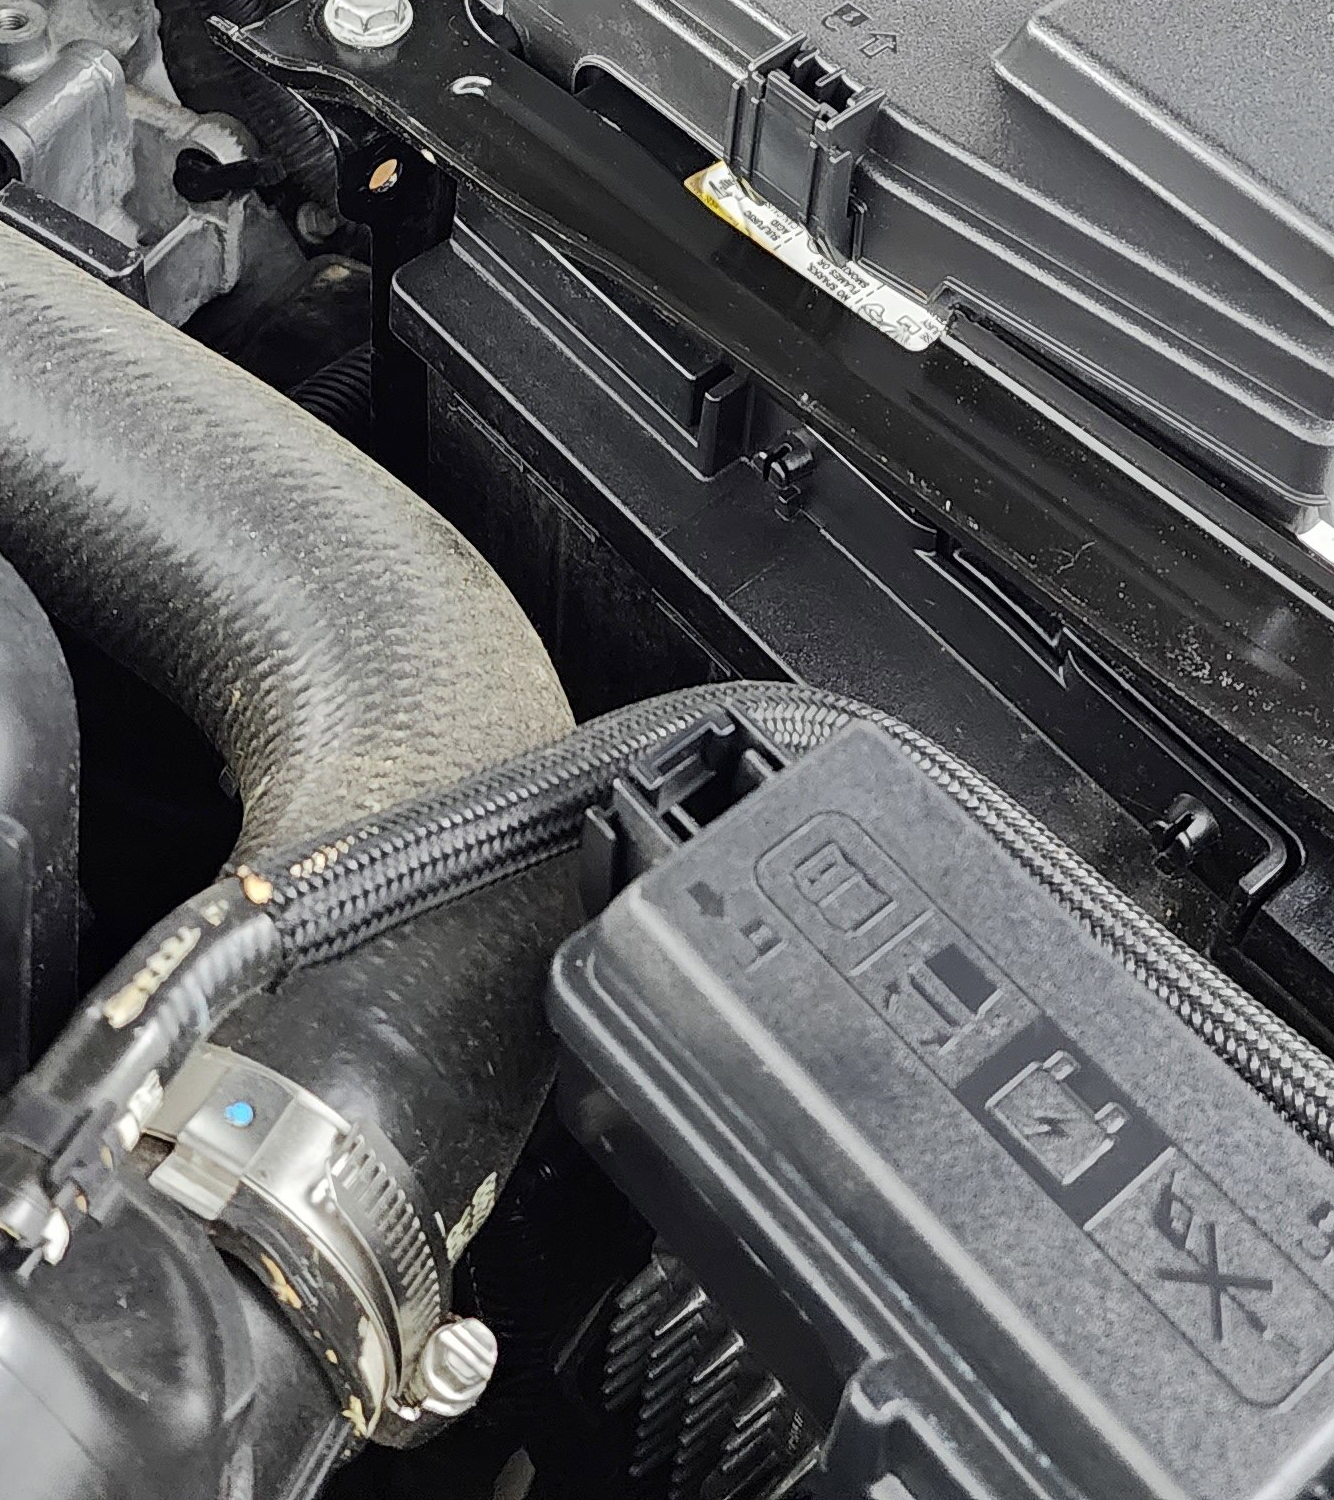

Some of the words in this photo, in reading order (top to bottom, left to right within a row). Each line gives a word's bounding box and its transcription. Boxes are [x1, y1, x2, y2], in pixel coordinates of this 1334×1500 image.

[770, 219, 791, 236] ACID
[829, 269, 861, 297] FLAMES
[836, 287, 852, 302] NO
